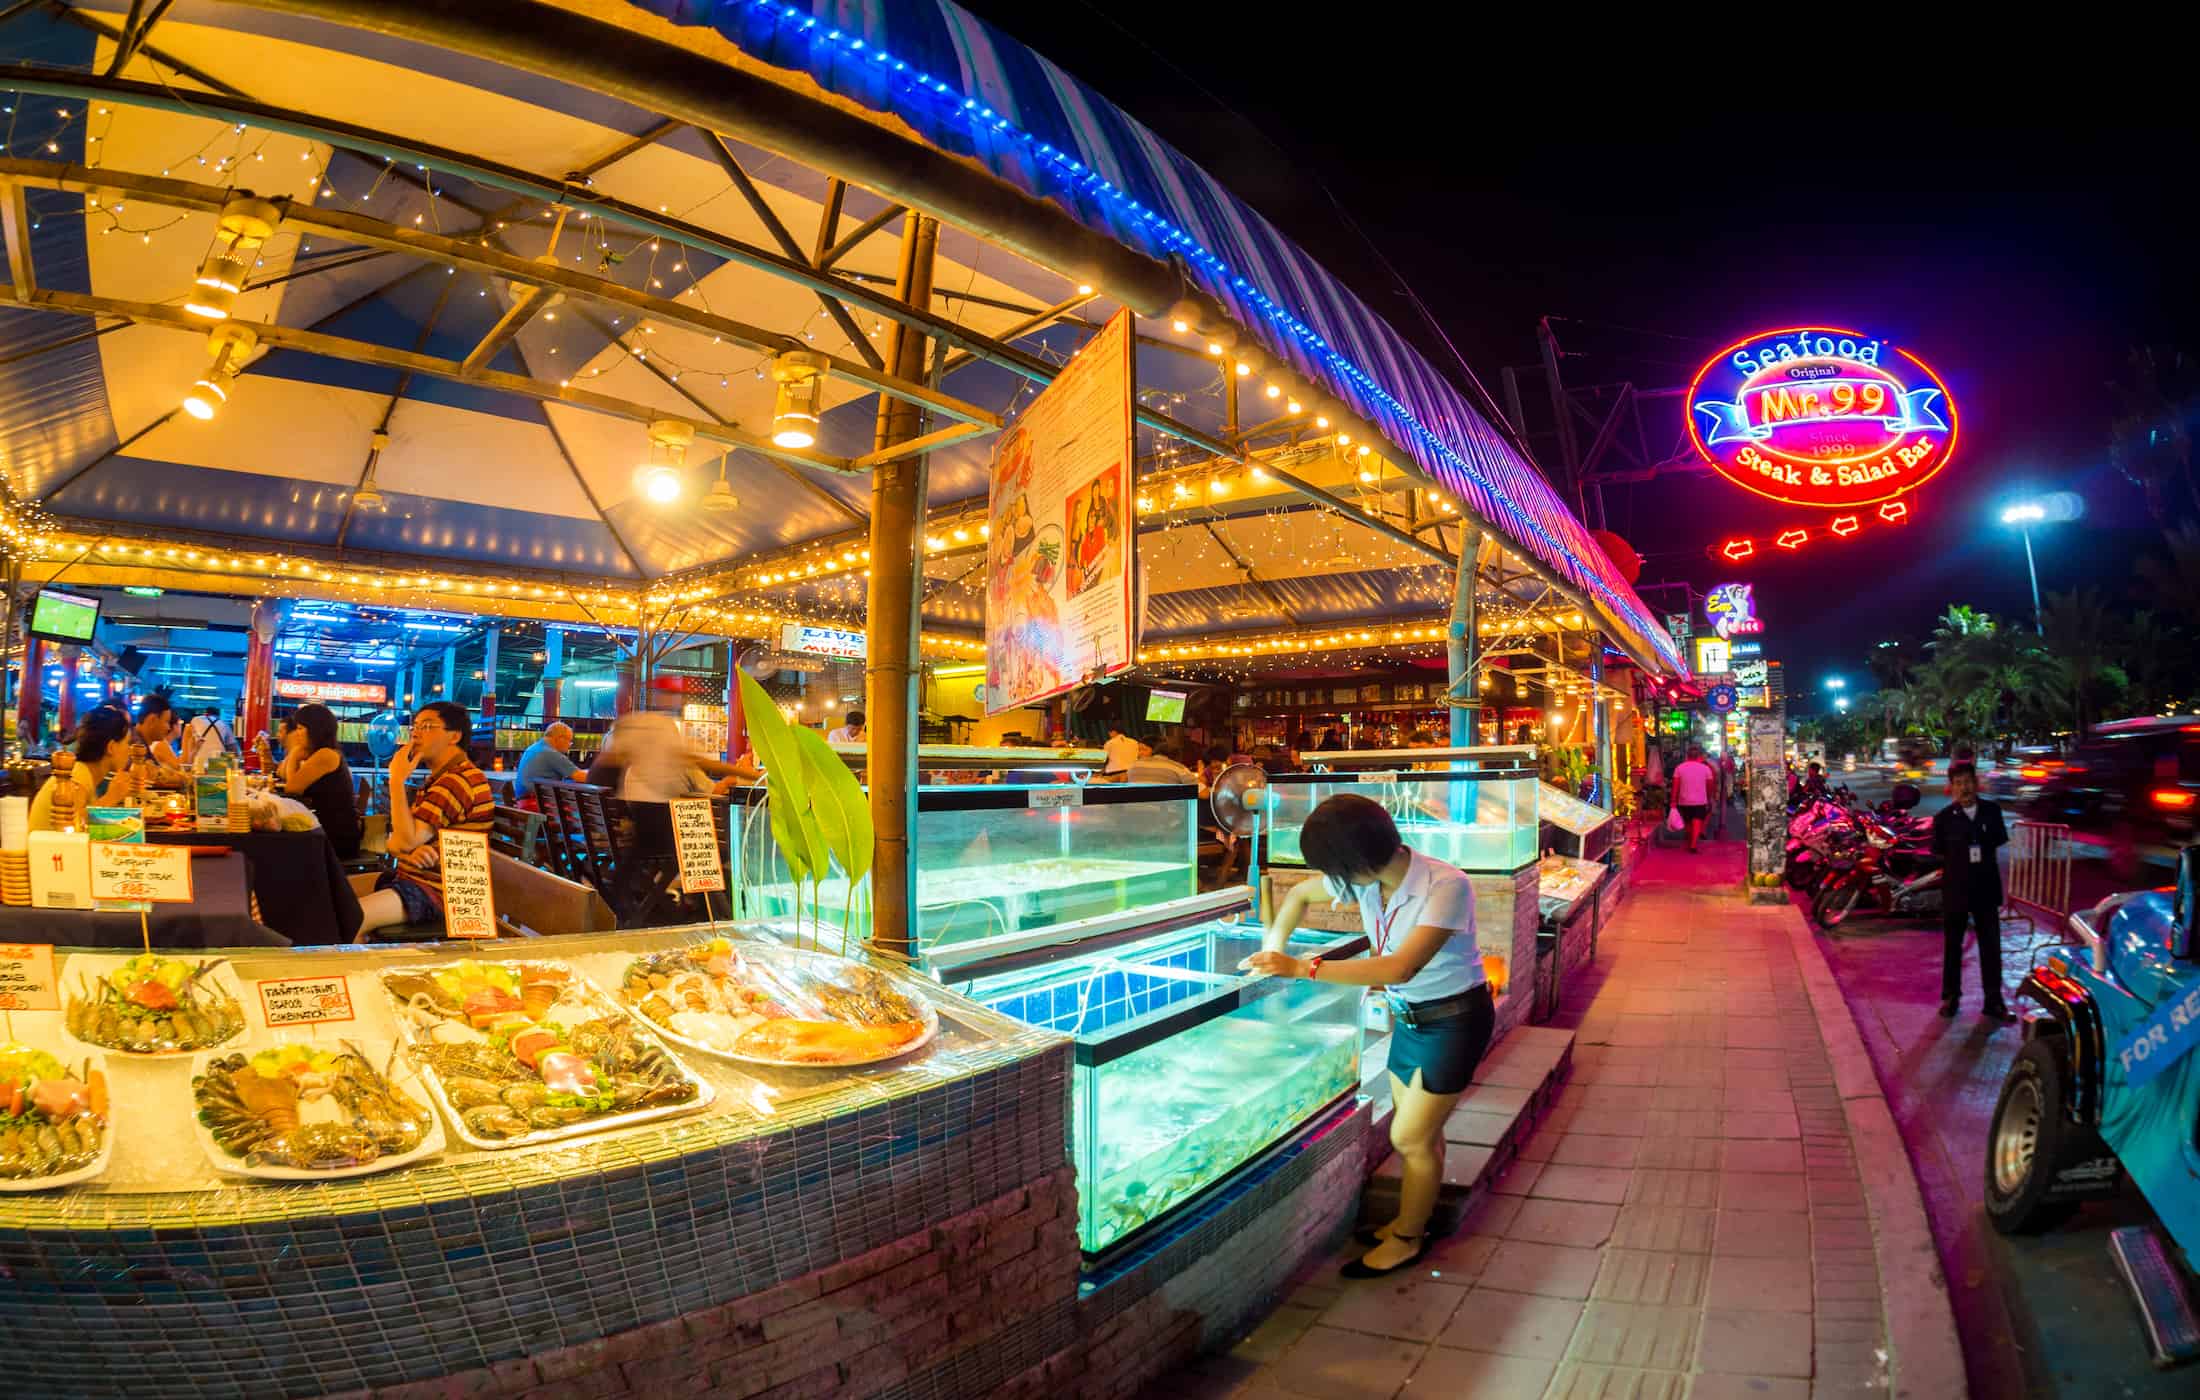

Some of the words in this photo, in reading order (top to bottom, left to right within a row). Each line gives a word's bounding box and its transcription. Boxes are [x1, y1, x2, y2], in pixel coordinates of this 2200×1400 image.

[1732, 331, 1880, 377] Seafood
[1790, 366, 1836, 378] Original
[1761, 383, 1885, 423] Mr.99
[1809, 432, 1849, 442] Since
[1736, 446, 1803, 485] Steak
[1810, 466, 1833, 485] &
[1837, 456, 1899, 486] Salad
[1896, 436, 1934, 469] Bar
[803, 628, 864, 643] LIVE
[803, 644, 861, 656] MUSIC
[2120, 1024, 2168, 1072] FOR
